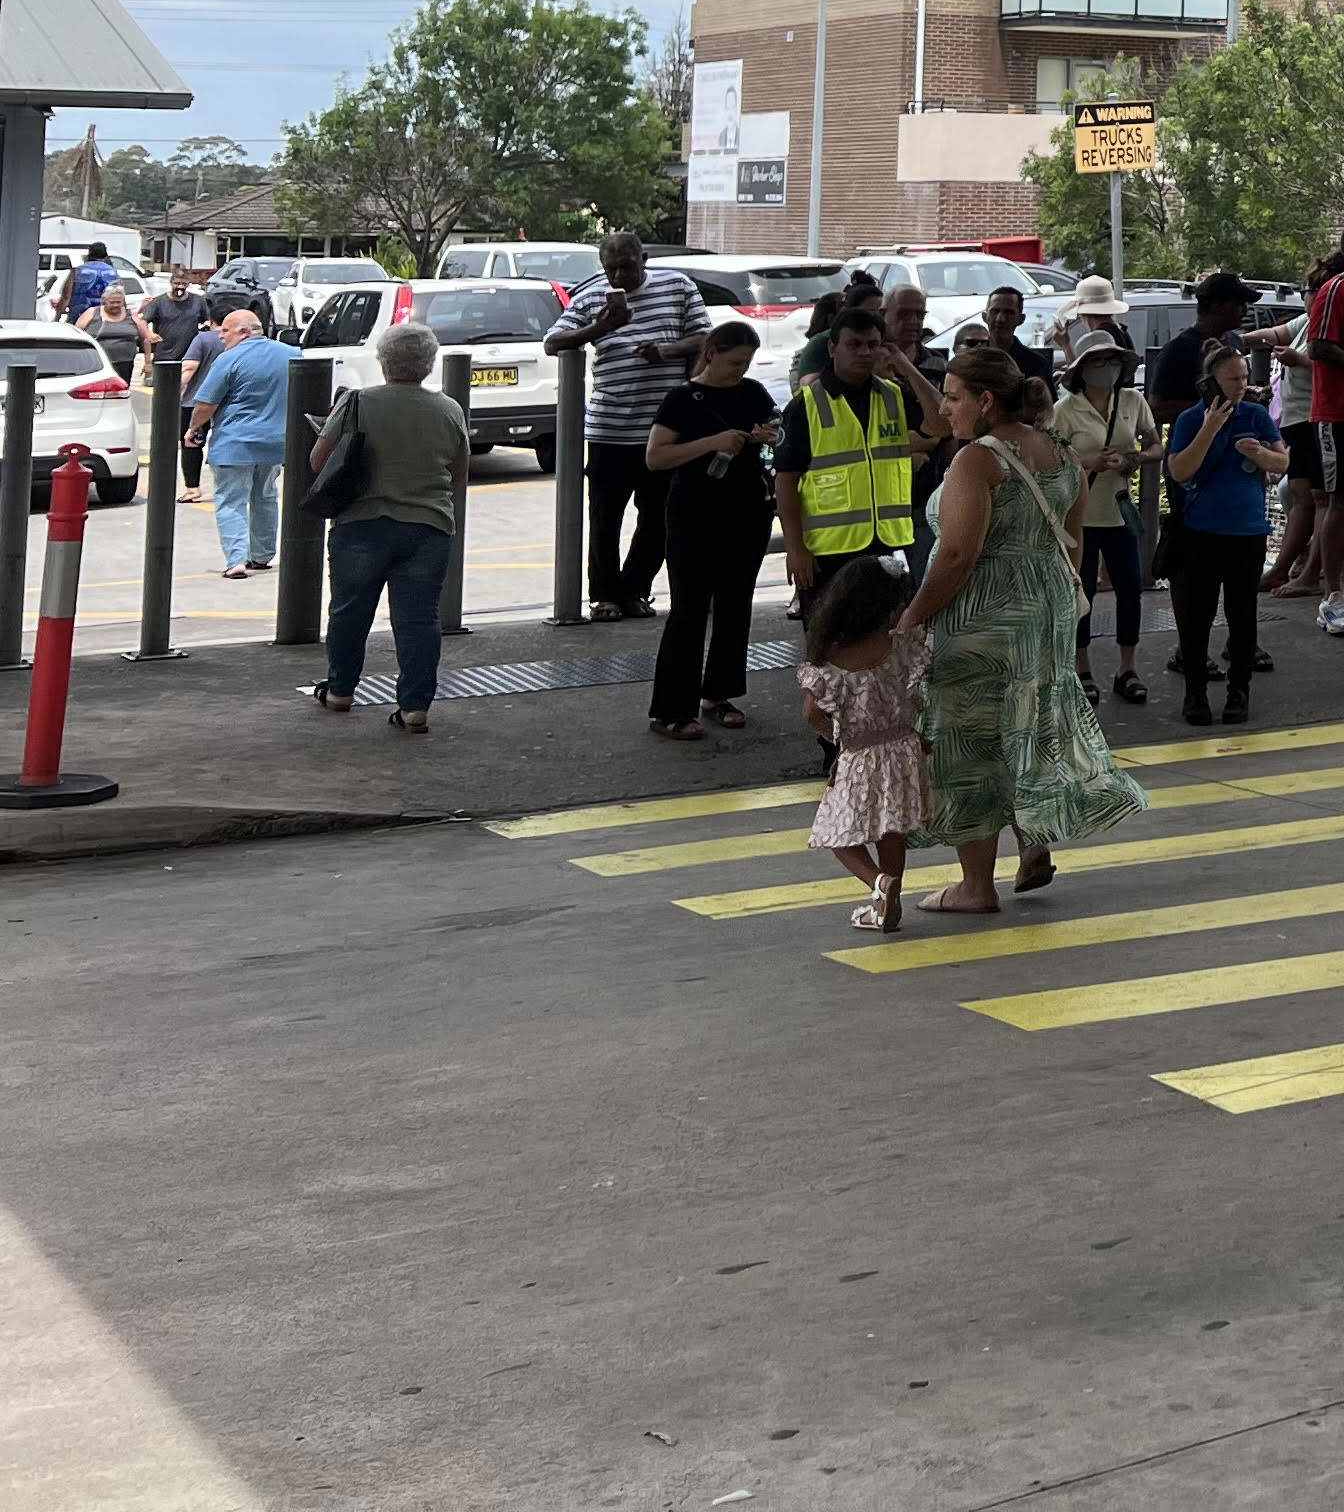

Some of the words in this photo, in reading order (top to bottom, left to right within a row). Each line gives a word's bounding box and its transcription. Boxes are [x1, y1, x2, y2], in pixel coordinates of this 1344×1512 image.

[1096, 105, 1152, 122] WARNING
[1091, 127, 1143, 147] TRUCKS
[1081, 145, 1152, 167] REVERSING
